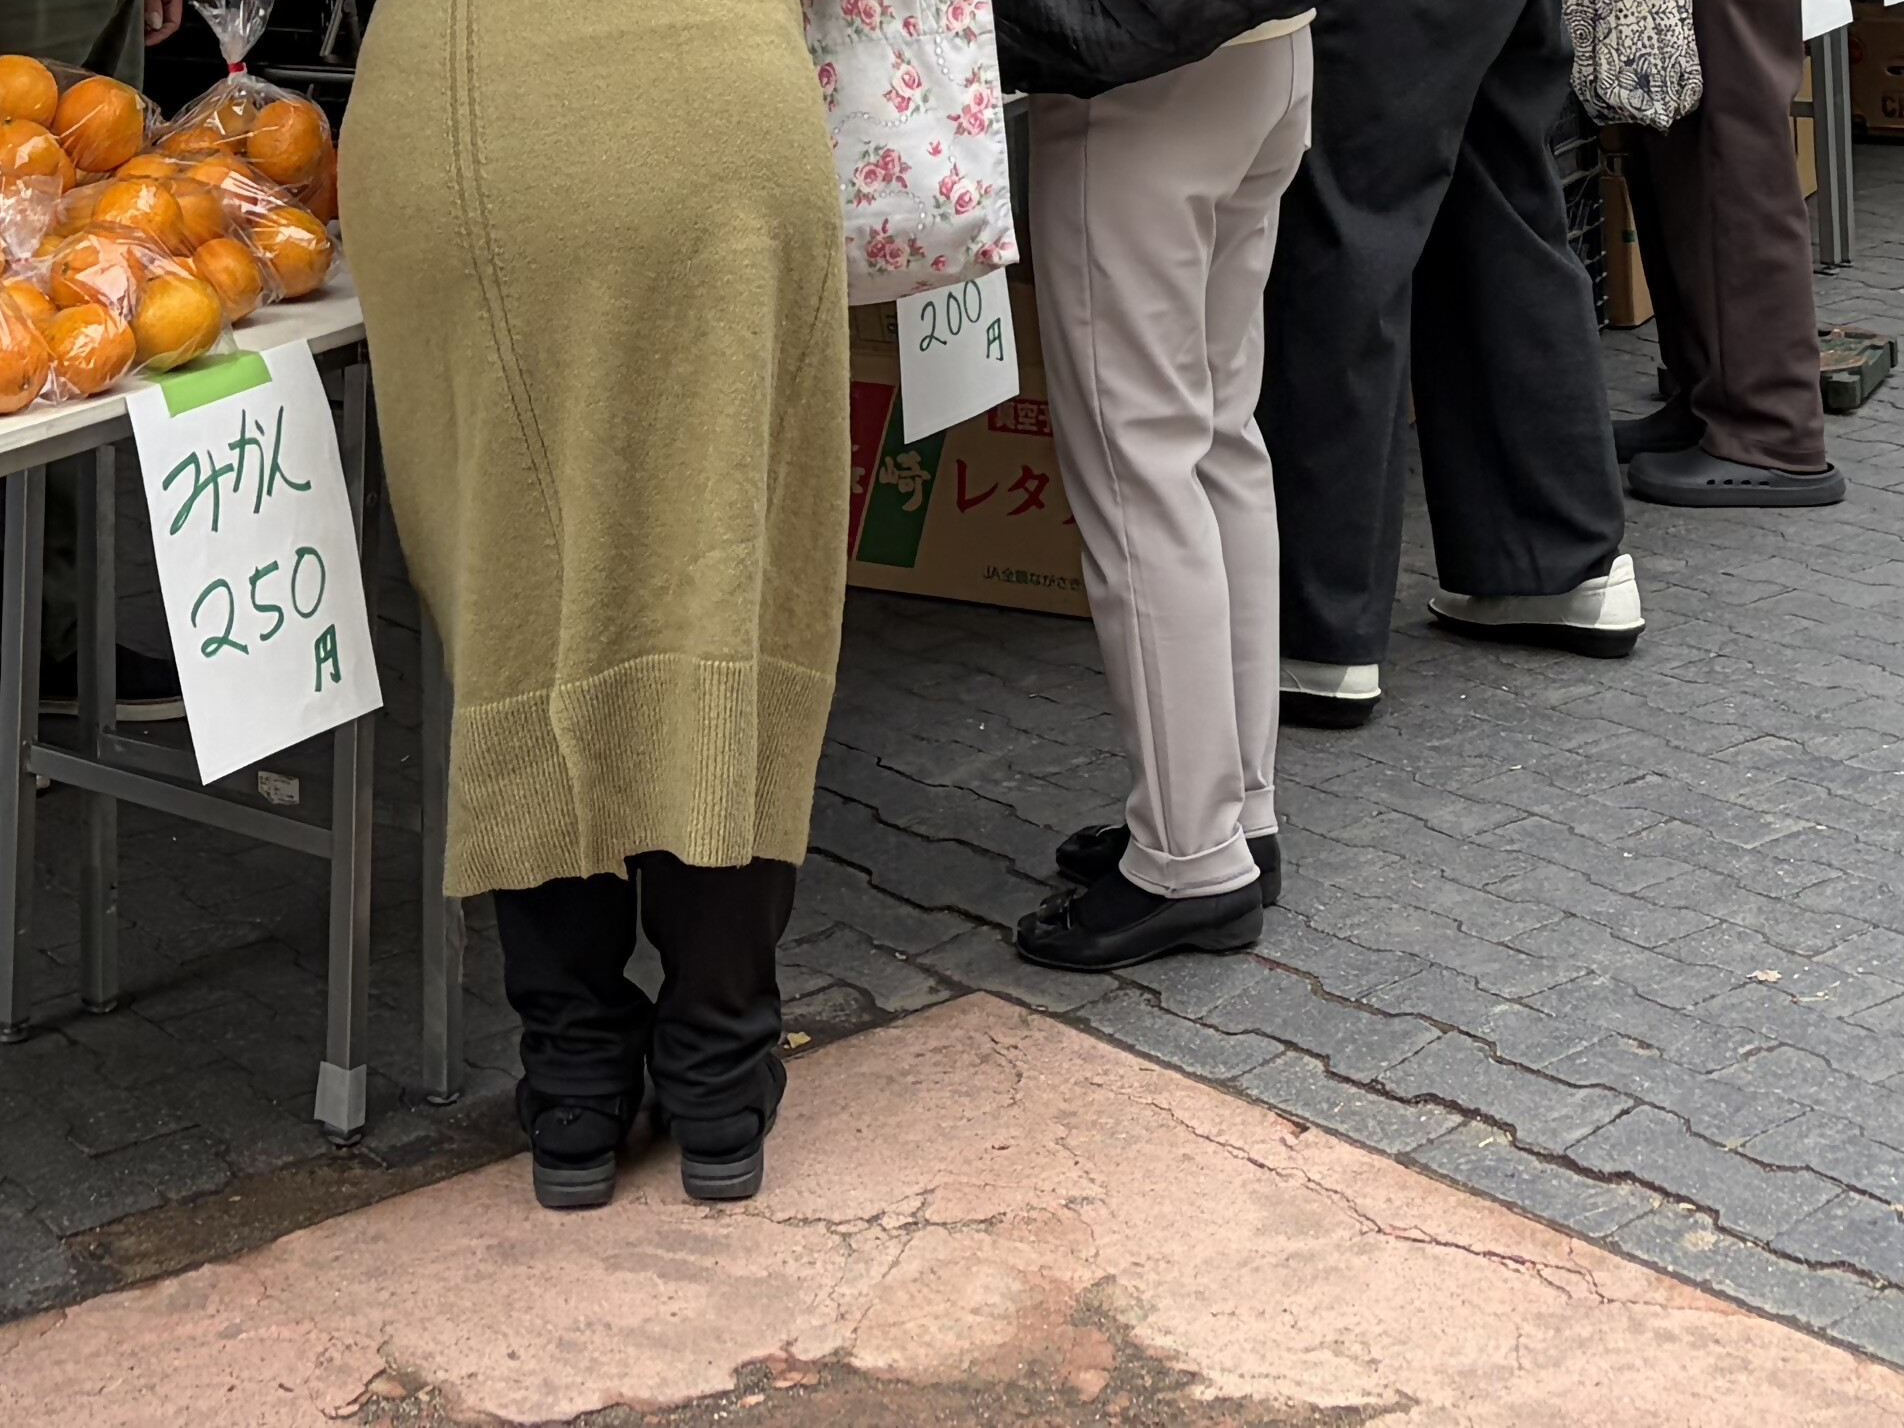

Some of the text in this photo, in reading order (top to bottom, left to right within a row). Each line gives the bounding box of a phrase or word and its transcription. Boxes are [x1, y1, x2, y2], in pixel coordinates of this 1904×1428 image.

[162, 405, 312, 535] みかん
[851, 445, 931, 512] 崎
[956, 459, 1076, 526] レタ
